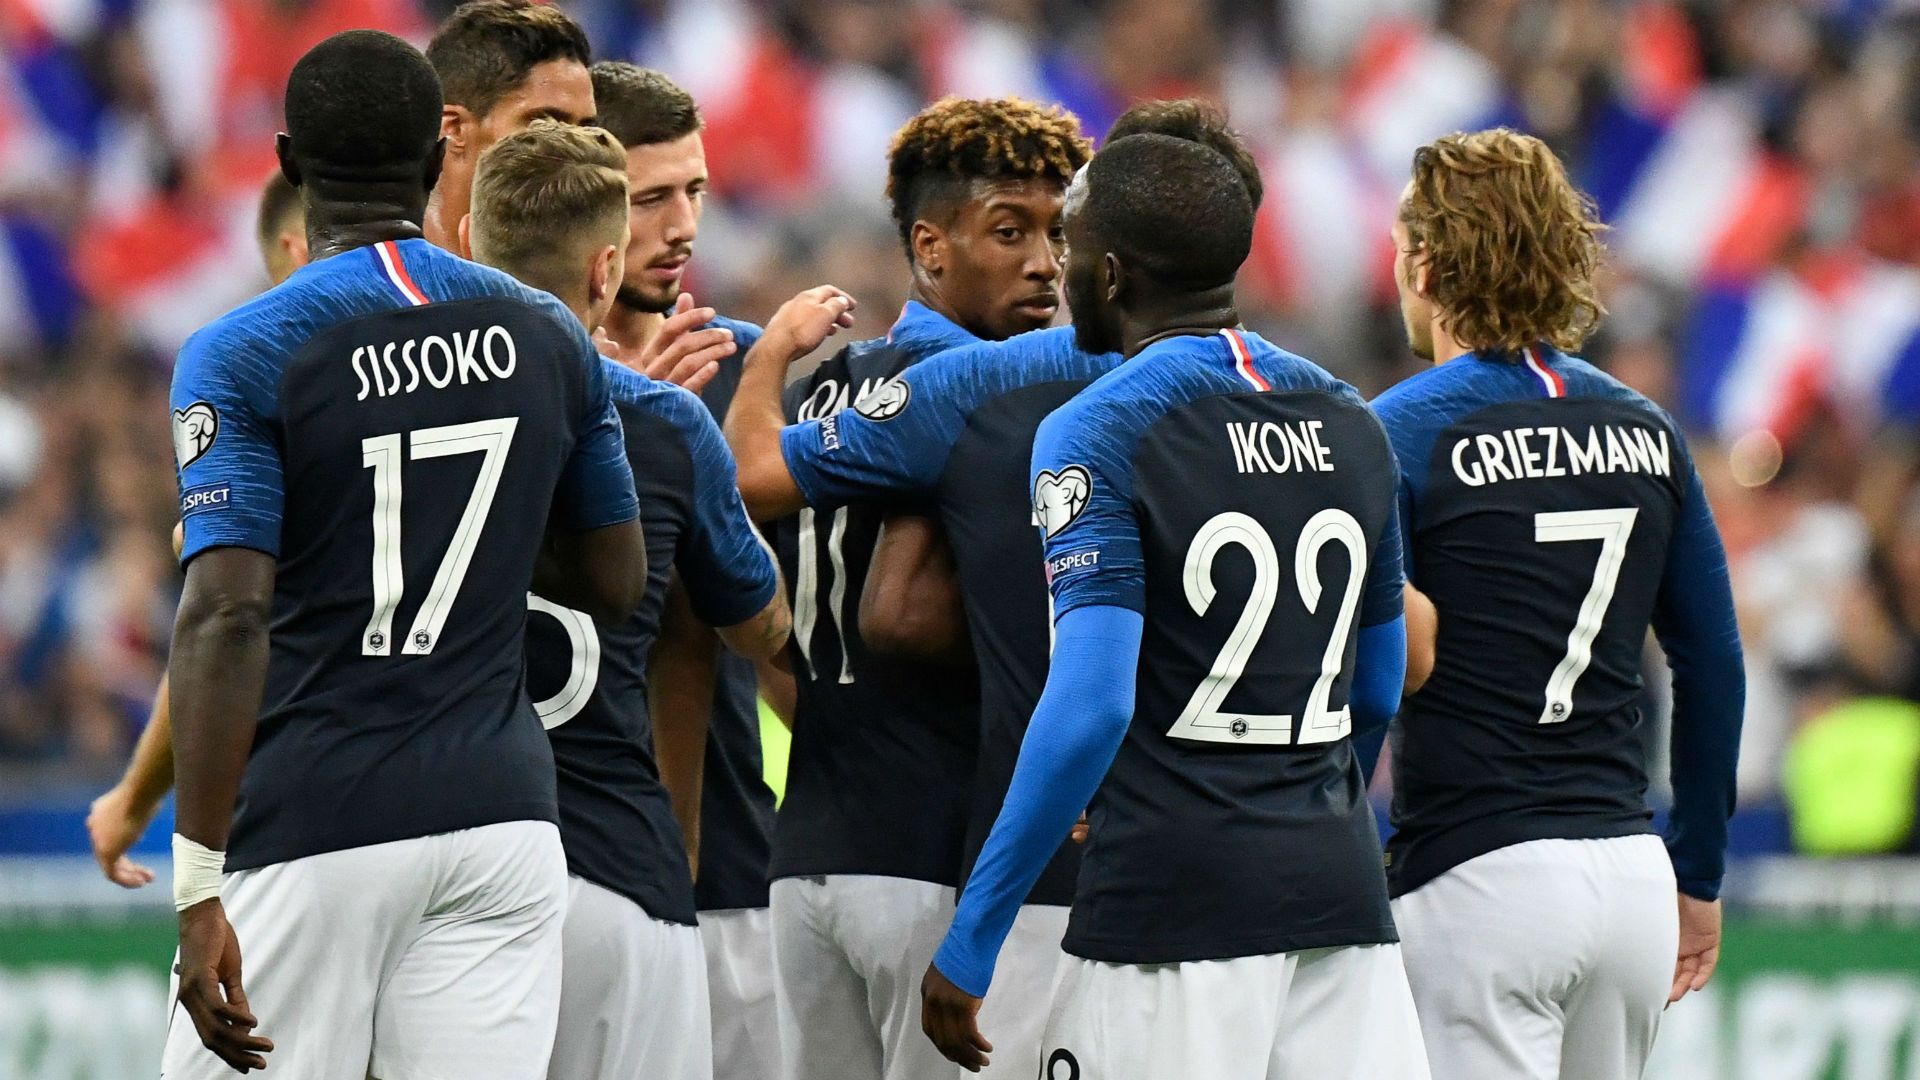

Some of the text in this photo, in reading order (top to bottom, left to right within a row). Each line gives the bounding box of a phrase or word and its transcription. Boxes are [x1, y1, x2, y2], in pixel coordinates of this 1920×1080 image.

[352, 326, 516, 401] SISSOKO
[1226, 421, 1335, 473] IKONE
[1452, 426, 1671, 486] GRIEZMANN
[362, 417, 519, 656] 17
[1166, 508, 1368, 745] 22
[1534, 507, 1640, 724] 7
